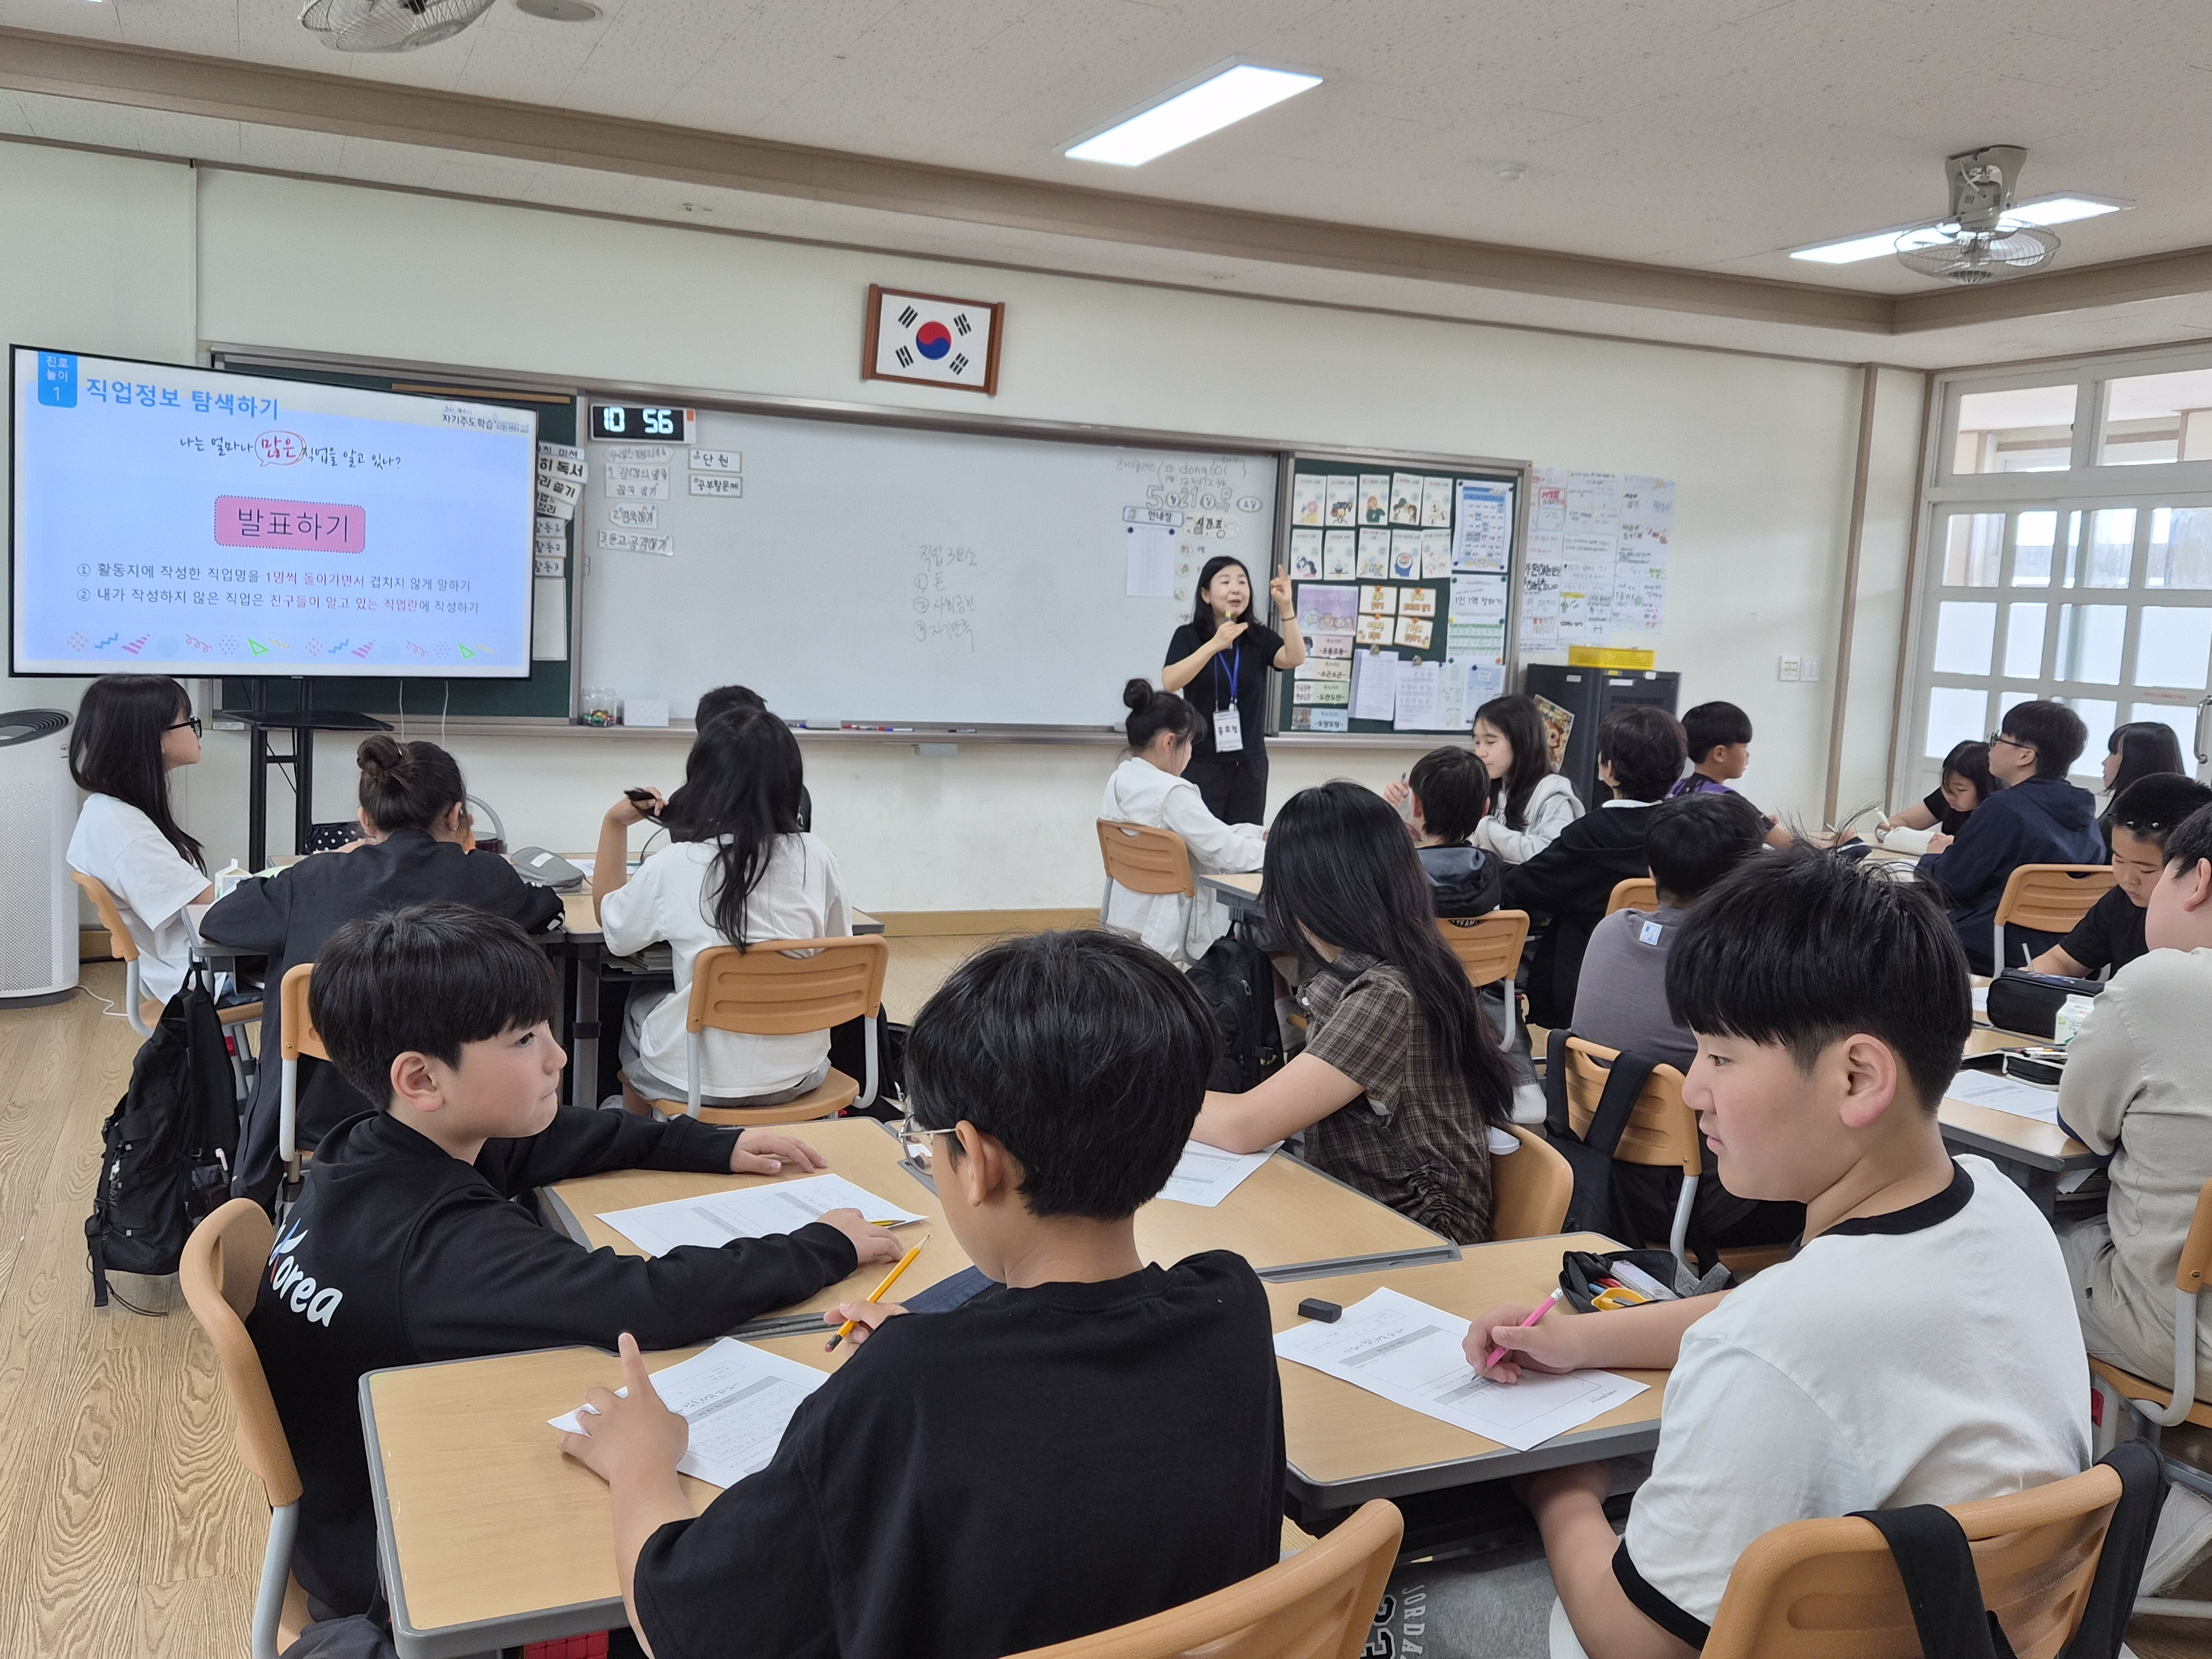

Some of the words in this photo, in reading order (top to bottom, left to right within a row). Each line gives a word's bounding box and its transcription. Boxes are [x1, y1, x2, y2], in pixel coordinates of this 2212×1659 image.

[46, 356, 69, 369] 진로
[53, 387, 60, 401] 1
[87, 378, 181, 407] 직업정보
[192, 390, 278, 420] 탐색하기
[443, 414, 494, 430] 자기주도학습
[603, 406, 625, 432] 10
[643, 408, 674, 434] 56
[180, 436, 204, 452] 나는
[211, 435, 253, 457] 얼마나
[261, 435, 296, 460] 많은
[302, 447, 338, 467] 직업을
[343, 448, 366, 468] 알고
[372, 453, 401, 470] 있나?
[539, 475, 552, 488] 리
[557, 461, 583, 477] 독서
[238, 508, 348, 542] 발표하기
[97, 563, 154, 578] 활동지에
[160, 566, 201, 581] 작성한
[208, 567, 260, 582] 직업명을
[266, 571, 297, 585] 1명씩
[304, 572, 364, 587] 돌아가면서
[371, 575, 404, 590] 겹치지
[410, 577, 432, 591] 않게
[438, 578, 470, 592] 말하기
[97, 588, 126, 602] 내가
[132, 588, 186, 604] 작성하지
[194, 591, 220, 605] 않은
[226, 592, 264, 607] 직업은
[270, 594, 320, 609] 친구들이
[326, 596, 349, 609] 알고
[356, 597, 378, 611] 있는
[434, 600, 478, 614] 작성하기
[268, 1217, 343, 1328] Korea
[1400, 1584, 1427, 1659] JORDA
